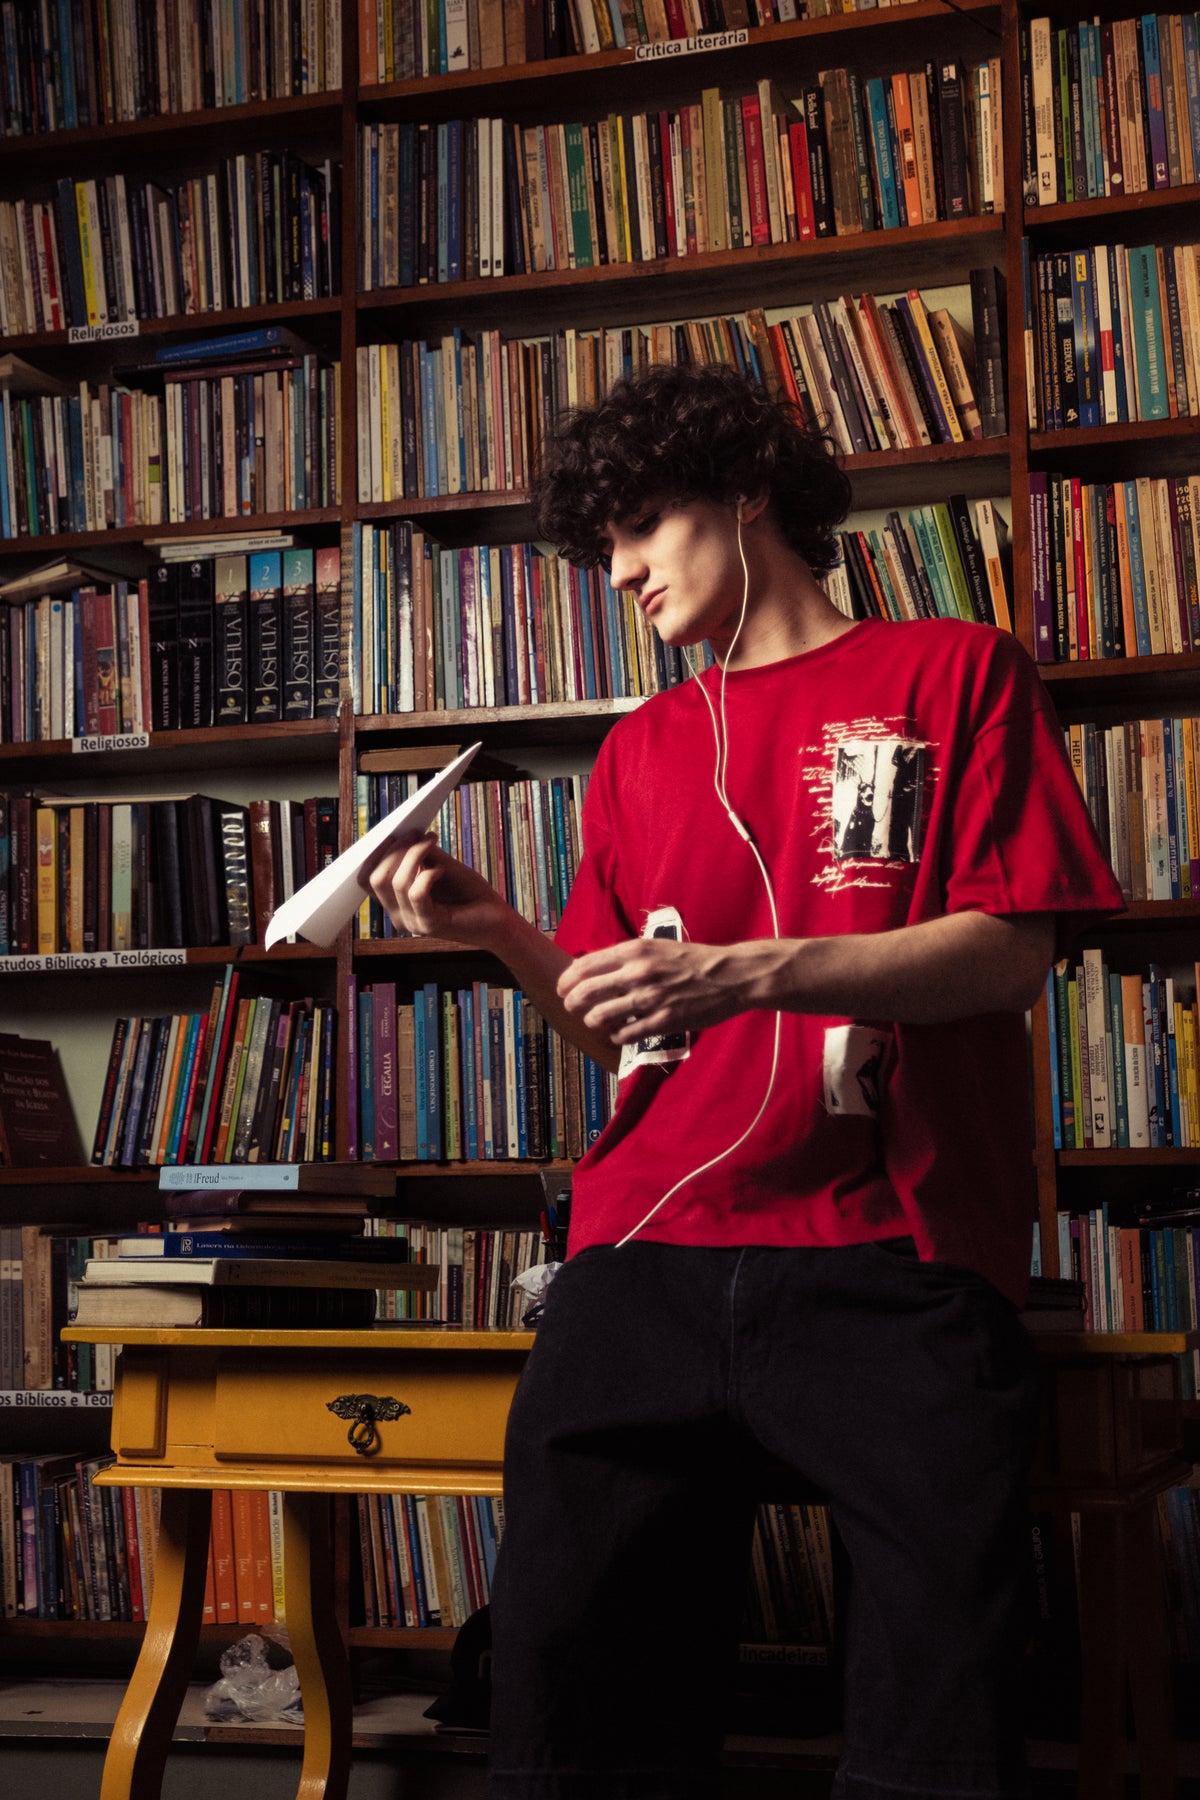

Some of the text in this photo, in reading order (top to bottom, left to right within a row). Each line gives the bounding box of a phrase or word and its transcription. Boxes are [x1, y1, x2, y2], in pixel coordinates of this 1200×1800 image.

[636, 31, 747, 59] Crítica Literária
[71, 323, 136, 342] Religiosos
[1168, 283, 1178, 320] SONHAR
[1176, 364, 1184, 384] BEM
[928, 348, 944, 381] PORTUGUÊS
[1062, 338, 1076, 384] REEDUCAÇÃO
[942, 389, 950, 404] PARA
[946, 406, 956, 424] LATIM
[982, 504, 990, 524] estudos
[1036, 500, 1044, 550] Assessoramento
[1074, 508, 1082, 542] Unicesumar
[228, 568, 233, 579] 1
[262, 566, 270, 581] 2
[293, 561, 301, 577] 3
[323, 558, 331, 572] 4
[960, 516, 970, 544] Catálogo
[968, 553, 977, 569] Teses
[973, 576, 987, 614] Dissertações
[992, 561, 1000, 587] semiótica
[1038, 550, 1046, 602] Psicopedagógico
[1056, 562, 1064, 572] ALÉM
[1056, 586, 1064, 600] MUROS
[219, 616, 244, 692] JOSHUA
[254, 616, 279, 692] JOSHUA
[286, 610, 311, 686] JOSHUA
[316, 608, 340, 684] JOSHUA
[160, 658, 170, 727] MATTHEW HENRY
[192, 656, 200, 725] MATTHEW HENRY
[81, 735, 147, 752] Religiosos
[1072, 740, 1080, 768] HELP!
[46, 955, 96, 970] Bíblicos
[100, 959, 108, 969] e
[113, 952, 184, 967] Teológicos
[1080, 1030, 1088, 1056] ESCOLA
[1113, 1004, 1122, 1067] Contemporaneidade
[383, 1052, 392, 1096] CEGALLA
[428, 1050, 438, 1114] CORRESPONDÊNCIA
[1082, 1064, 1090, 1100] GRAMSCI
[196, 1172, 220, 1184] Freud
[197, 1242, 220, 1250] Lasers
[16, 1392, 66, 1406] Bíblicos
[71, 1396, 78, 1406] e
[272, 1519, 282, 1564] Humanidade
[274, 1577, 283, 1597] Bíblia
